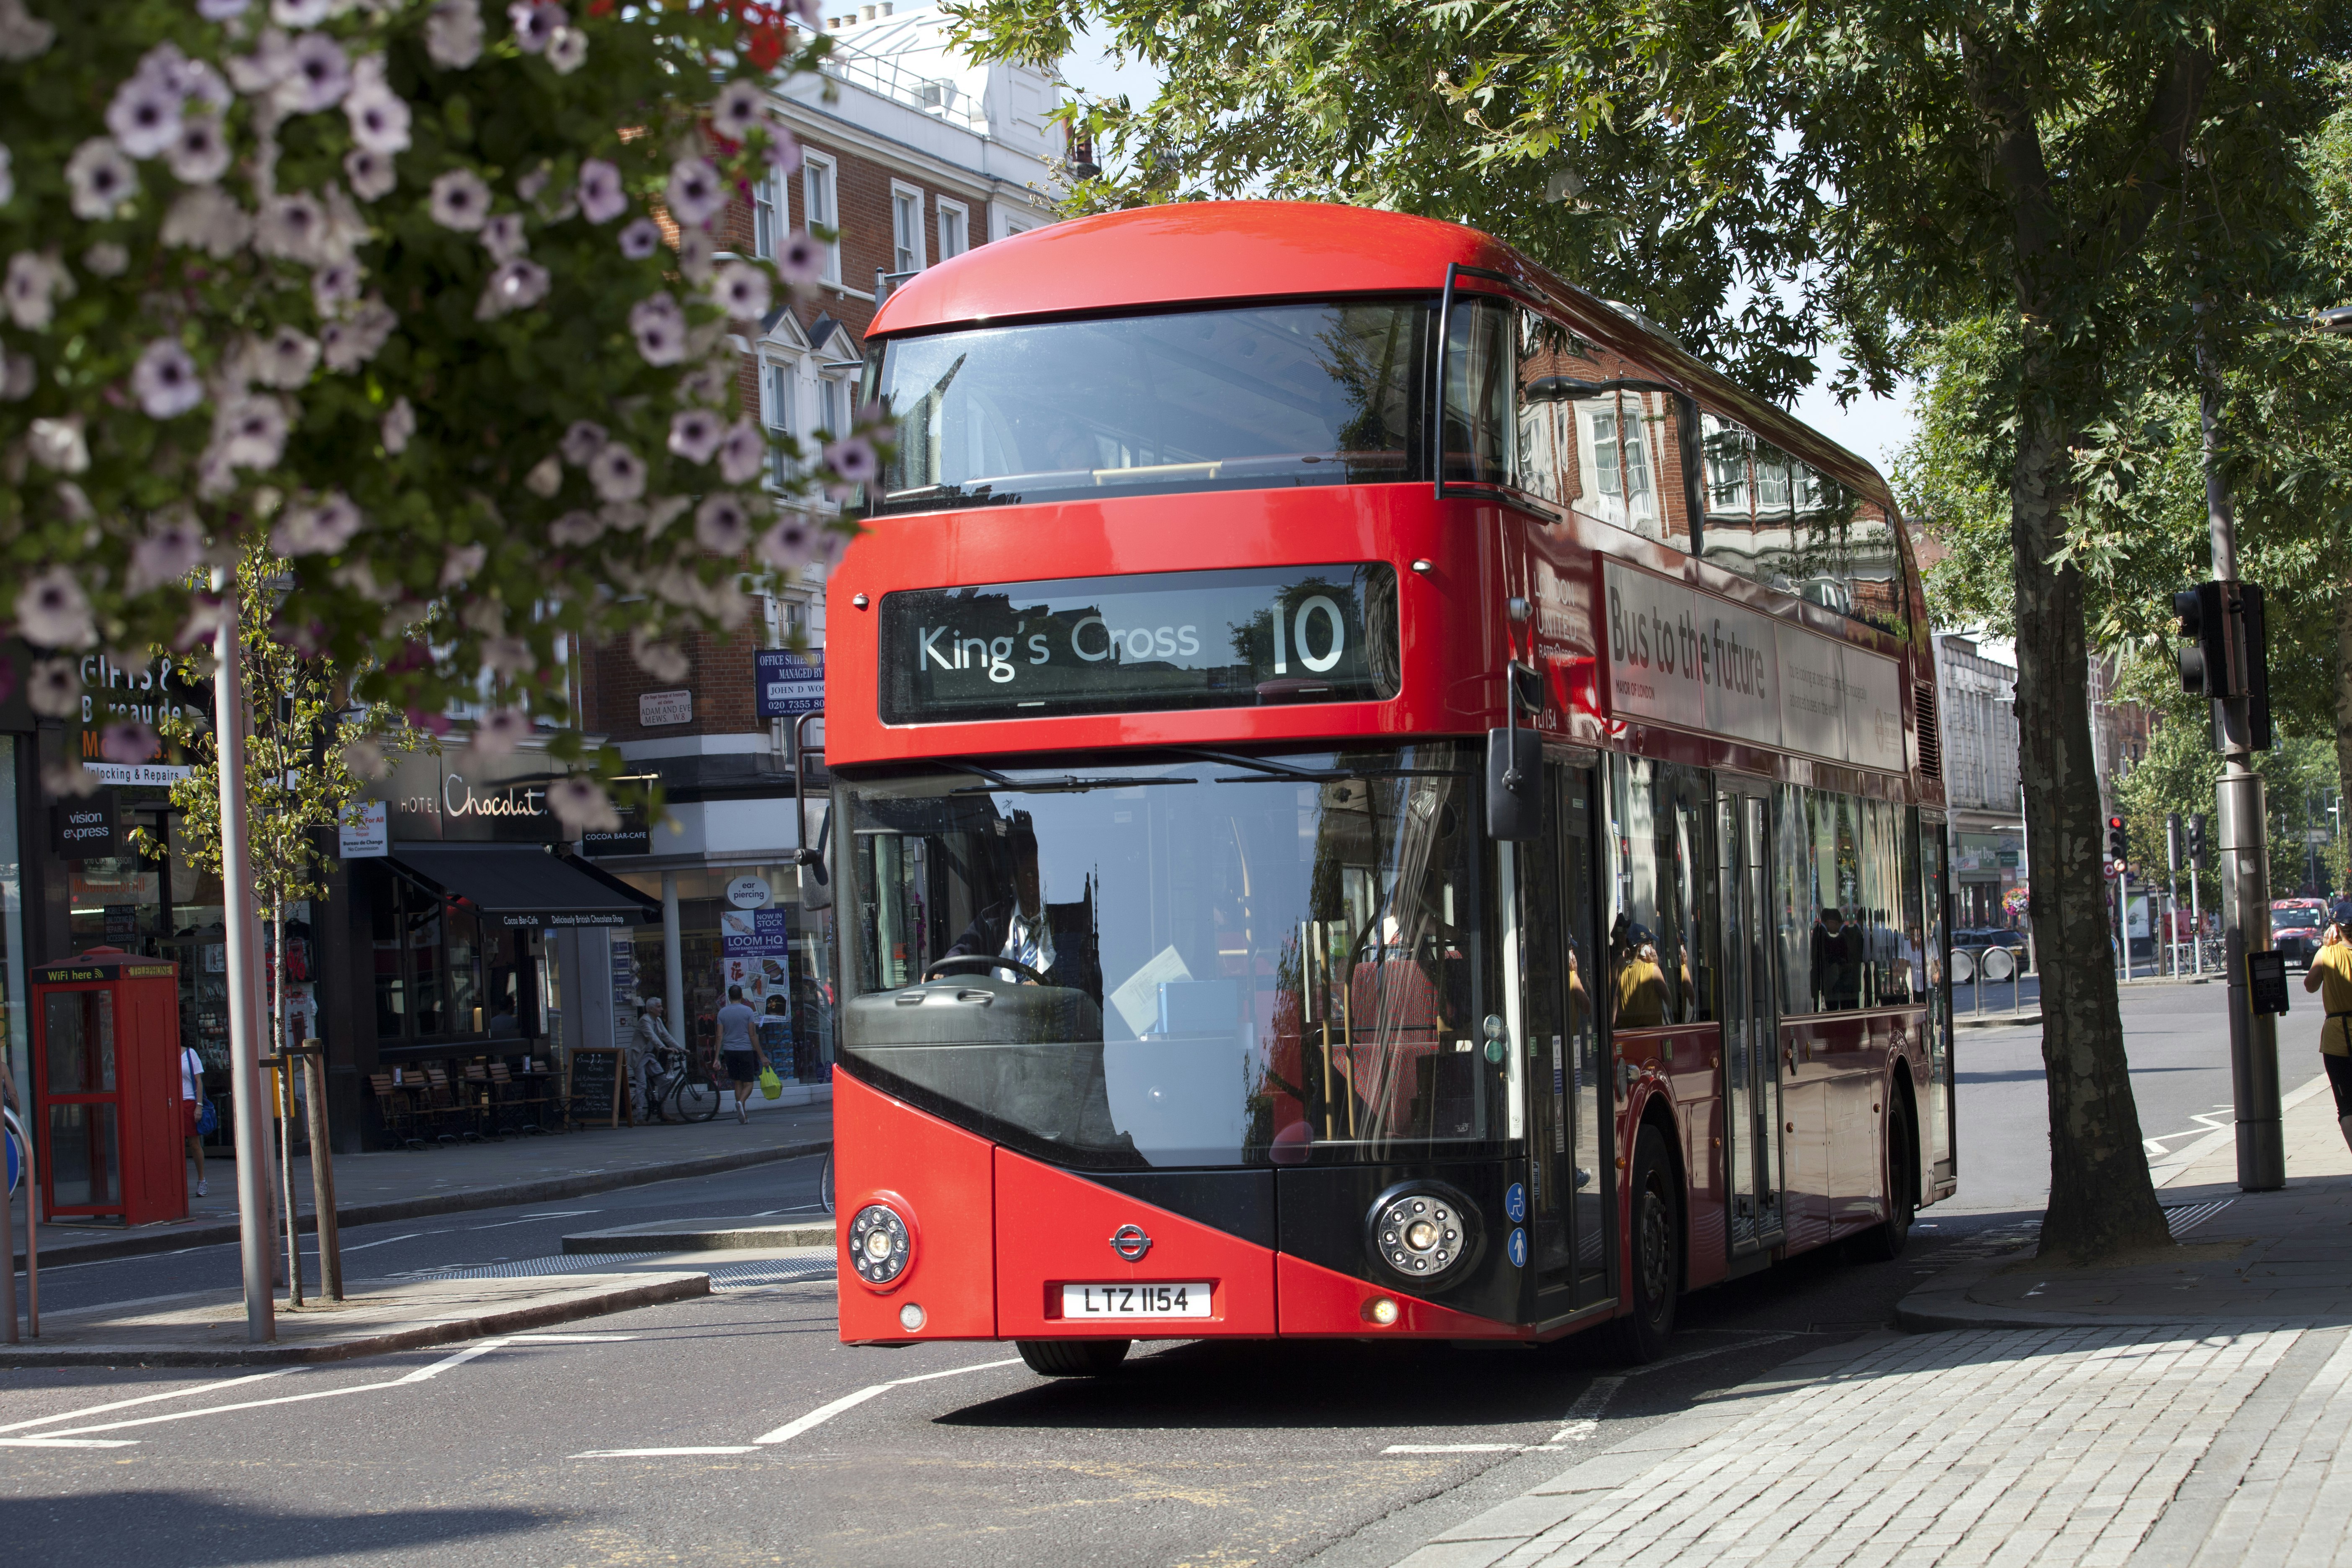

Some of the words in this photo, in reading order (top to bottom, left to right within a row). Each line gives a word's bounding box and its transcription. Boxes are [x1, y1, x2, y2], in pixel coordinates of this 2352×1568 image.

[1534, 571, 1575, 607] LONDON
[1536, 607, 1577, 642] UNITED
[919, 621, 1050, 683] King's
[1071, 616, 1199, 661] Cross
[1272, 595, 1344, 674] 10
[1610, 585, 1649, 669] Bus
[1653, 606, 1675, 675] to
[1678, 610, 1710, 685] the
[1713, 618, 1765, 699] future
[760, 655, 784, 666] OFFICE
[785, 654, 808, 665] SUITES
[812, 653, 821, 664] TO
[1539, 643, 1553, 660] RATP
[1561, 648, 1578, 666] GROUP
[779, 668, 812, 679] MANAGED
[814, 668, 823, 678] BY
[1799, 664, 1812, 688] looking
[1812, 671, 1816, 685] at
[1824, 672, 1828, 688] of
[771, 686, 794, 696] JOHN
[1616, 678, 1630, 695] MAYOR
[1631, 683, 1637, 696] OF
[1637, 684, 1655, 701] LONDON
[82, 696, 152, 724] Breau
[159, 698, 181, 725] de
[641, 707, 660, 716] ADAM
[662, 705, 677, 714] AND
[679, 704, 691, 712] EVE
[789, 700, 810, 709] 7355
[1790, 691, 1806, 710] advanced
[1806, 694, 1817, 712] buses
[1818, 698, 1821, 714] in
[1828, 702, 1839, 718] world
[84, 766, 130, 782] Unlocking
[135, 768, 140, 779] &
[144, 769, 179, 783] Repairs
[401, 797, 440, 813] HOTEL
[70, 811, 102, 824] vision
[64, 826, 109, 841] express
[734, 890, 764, 900] piercing
[503, 916, 518, 925] Cocoa
[518, 916, 538, 924] Bar-Cafe
[552, 915, 575, 926] Deliciously
[575, 915, 590, 923] British
[591, 915, 612, 923] Chocolate
[612, 914, 623, 924] Shop
[728, 936, 762, 946] LOOM
[766, 935, 783, 944] HQ
[48, 970, 68, 981] WiFi
[72, 970, 92, 980] here
[134, 965, 170, 976] TELEPHONE
[1085, 1288, 1134, 1311] LTZ
[1142, 1288, 1188, 1311] 1154
